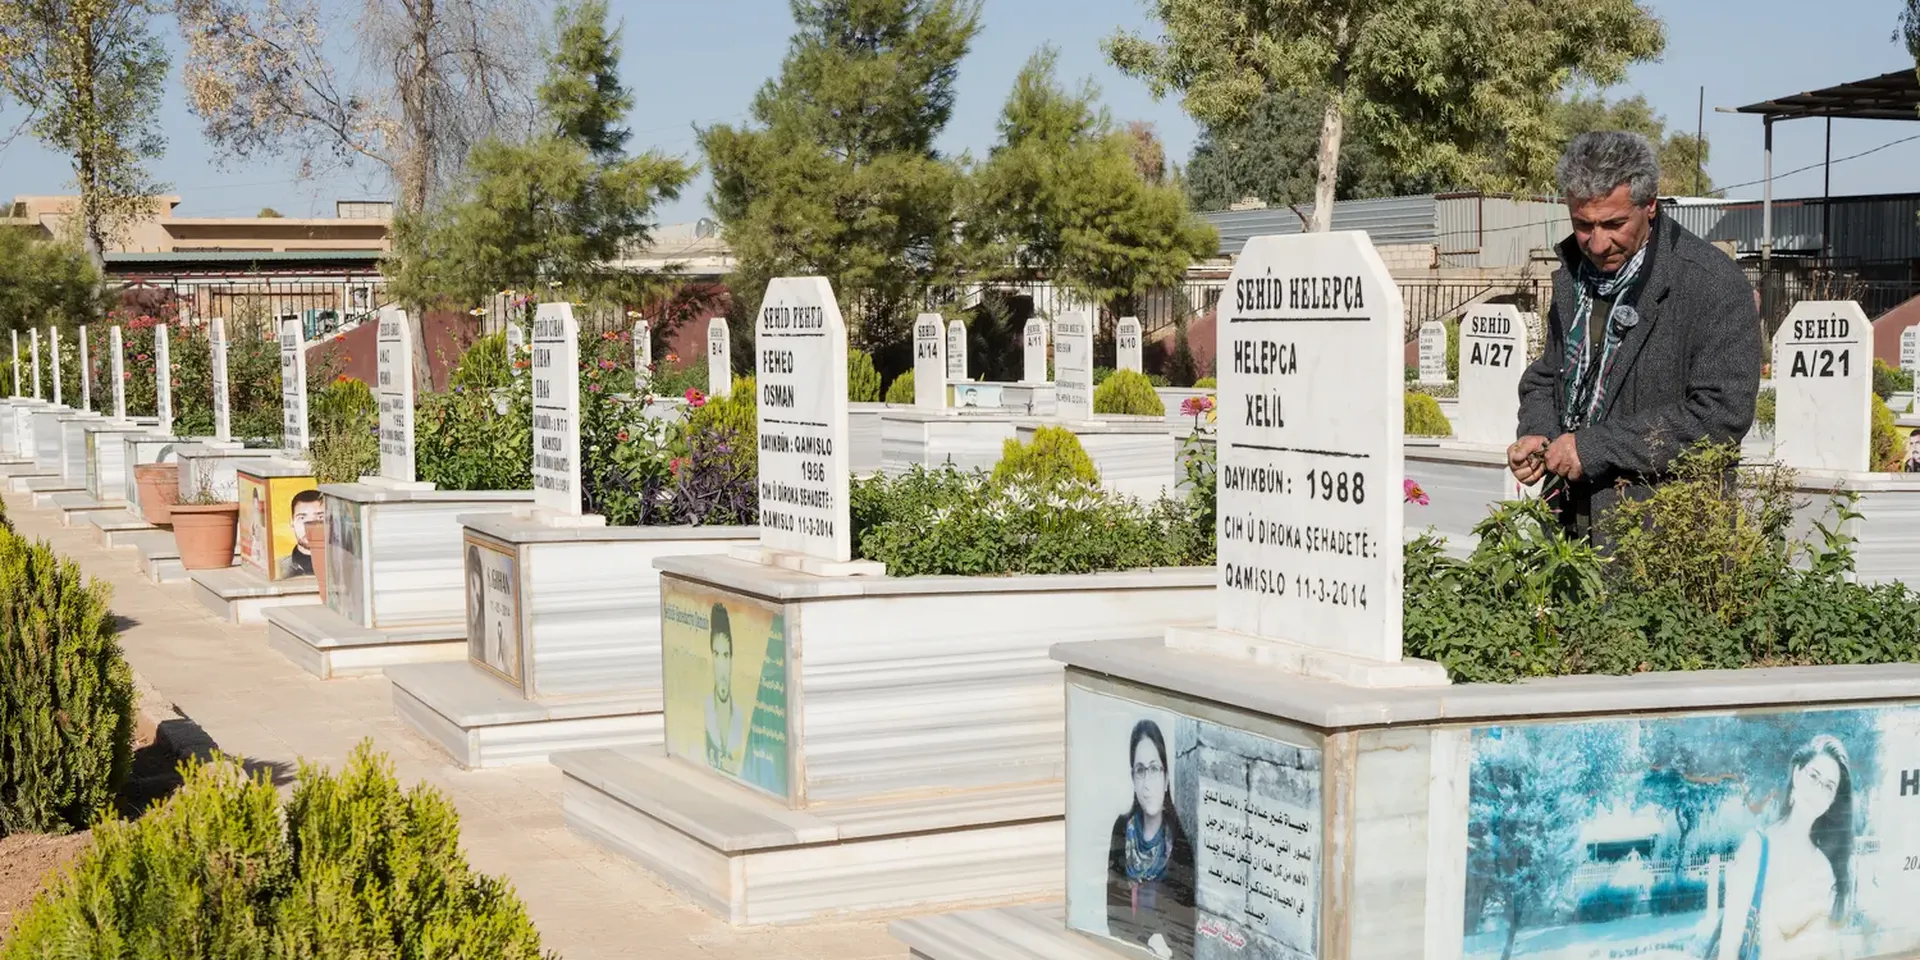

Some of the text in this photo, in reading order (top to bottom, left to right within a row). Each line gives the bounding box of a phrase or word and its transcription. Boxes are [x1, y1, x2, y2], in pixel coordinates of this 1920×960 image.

[1236, 266, 1364, 314] ŞEHÎD HELEPÇA
[1472, 312, 1511, 335] ŞEHÎD
[1794, 312, 1850, 341] ŞEHÎD
[918, 342, 938, 359] A/14
[1120, 337, 1136, 349] A/10
[1470, 342, 1514, 368] A/27
[1790, 350, 1850, 378] A/21
[763, 384, 795, 408] OSMAN
[1306, 468, 1365, 505] 1988
[1225, 515, 1243, 540] CIH
[1903, 855, 1920, 871] 20
